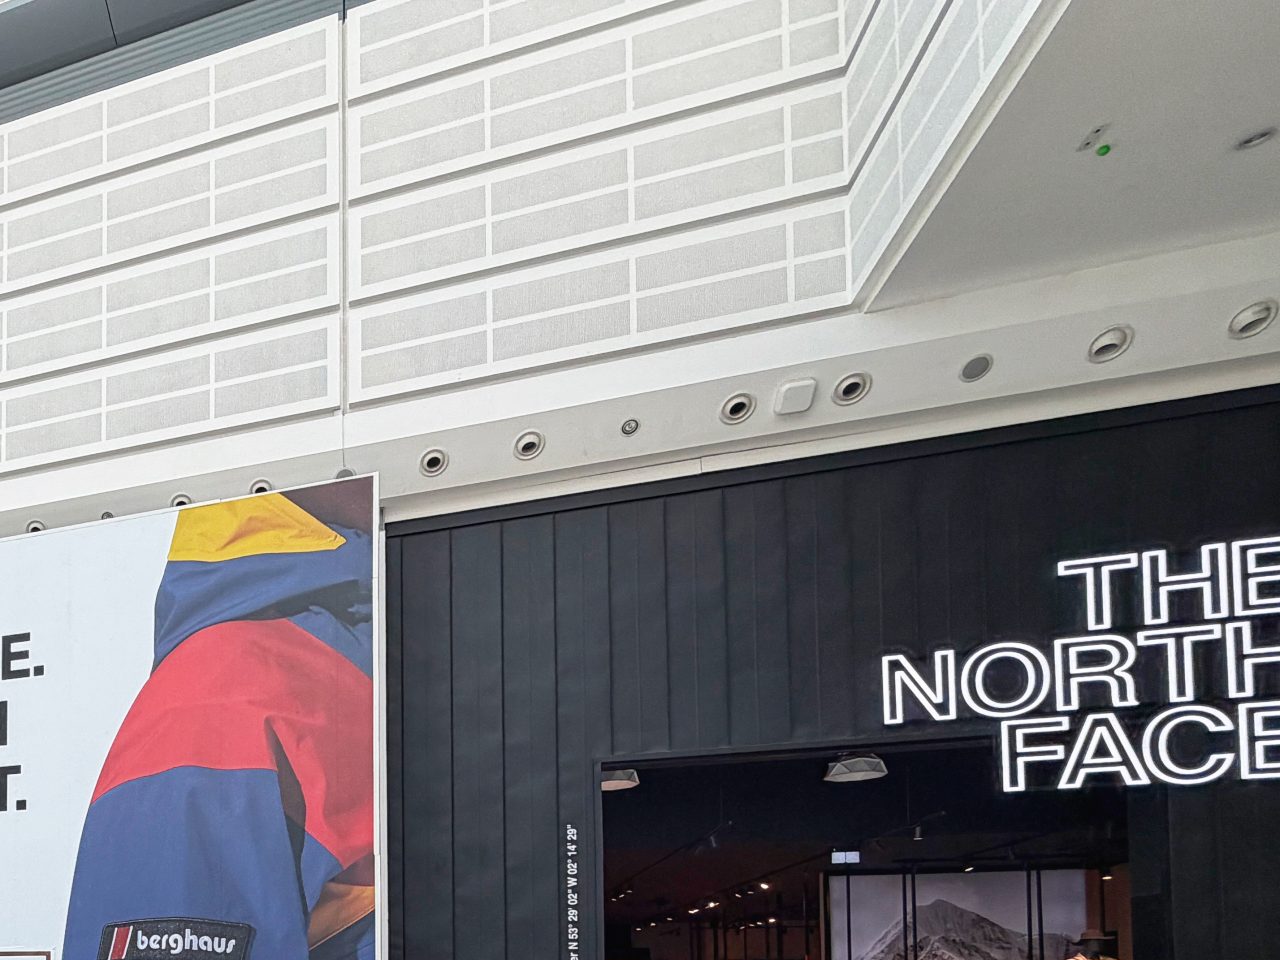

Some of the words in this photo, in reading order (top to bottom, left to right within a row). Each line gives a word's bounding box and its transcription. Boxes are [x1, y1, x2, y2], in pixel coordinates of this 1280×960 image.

[1057, 535, 1280, 631] THE
[881, 621, 1280, 725] NORTH
[1001, 699, 1280, 793] FACE
[566, 876, 578, 888] W
[136, 929, 236, 955] berghaus
[567, 941, 579, 950] N
